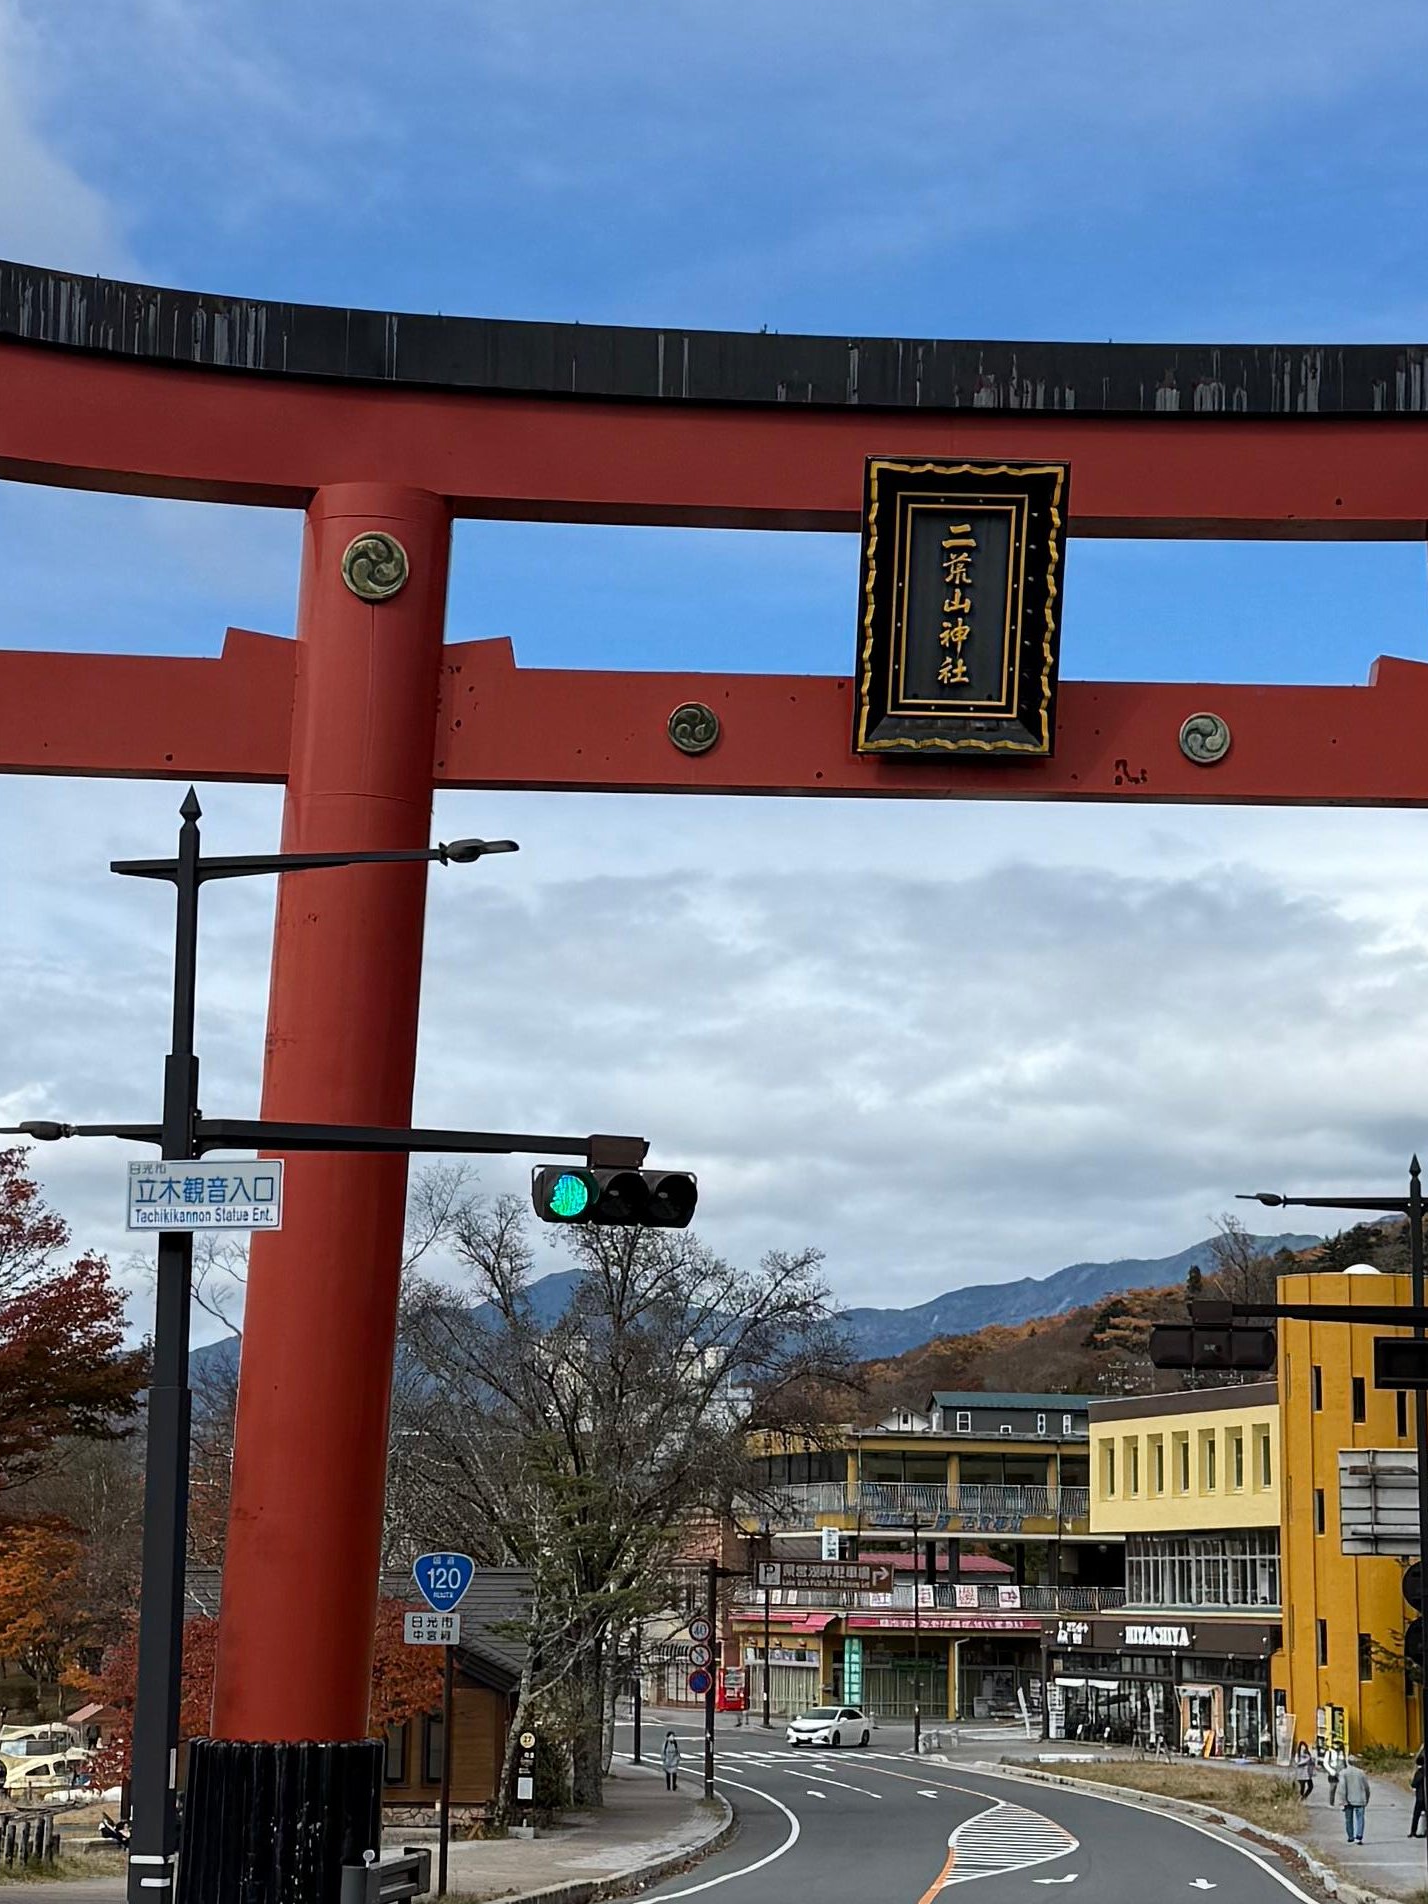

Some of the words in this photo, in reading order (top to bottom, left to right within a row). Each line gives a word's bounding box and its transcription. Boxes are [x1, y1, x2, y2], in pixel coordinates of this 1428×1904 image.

[937, 524, 976, 684] 二荒山神社
[129, 1163, 167, 1175] 日光市
[135, 1176, 274, 1204] 立木観音入口
[135, 1207, 211, 1224] Tachikikannon
[215, 1207, 249, 1223] Statue
[252, 1207, 273, 1222] Ent.
[427, 1567, 461, 1589] 120
[412, 1616, 453, 1628] 日光市
